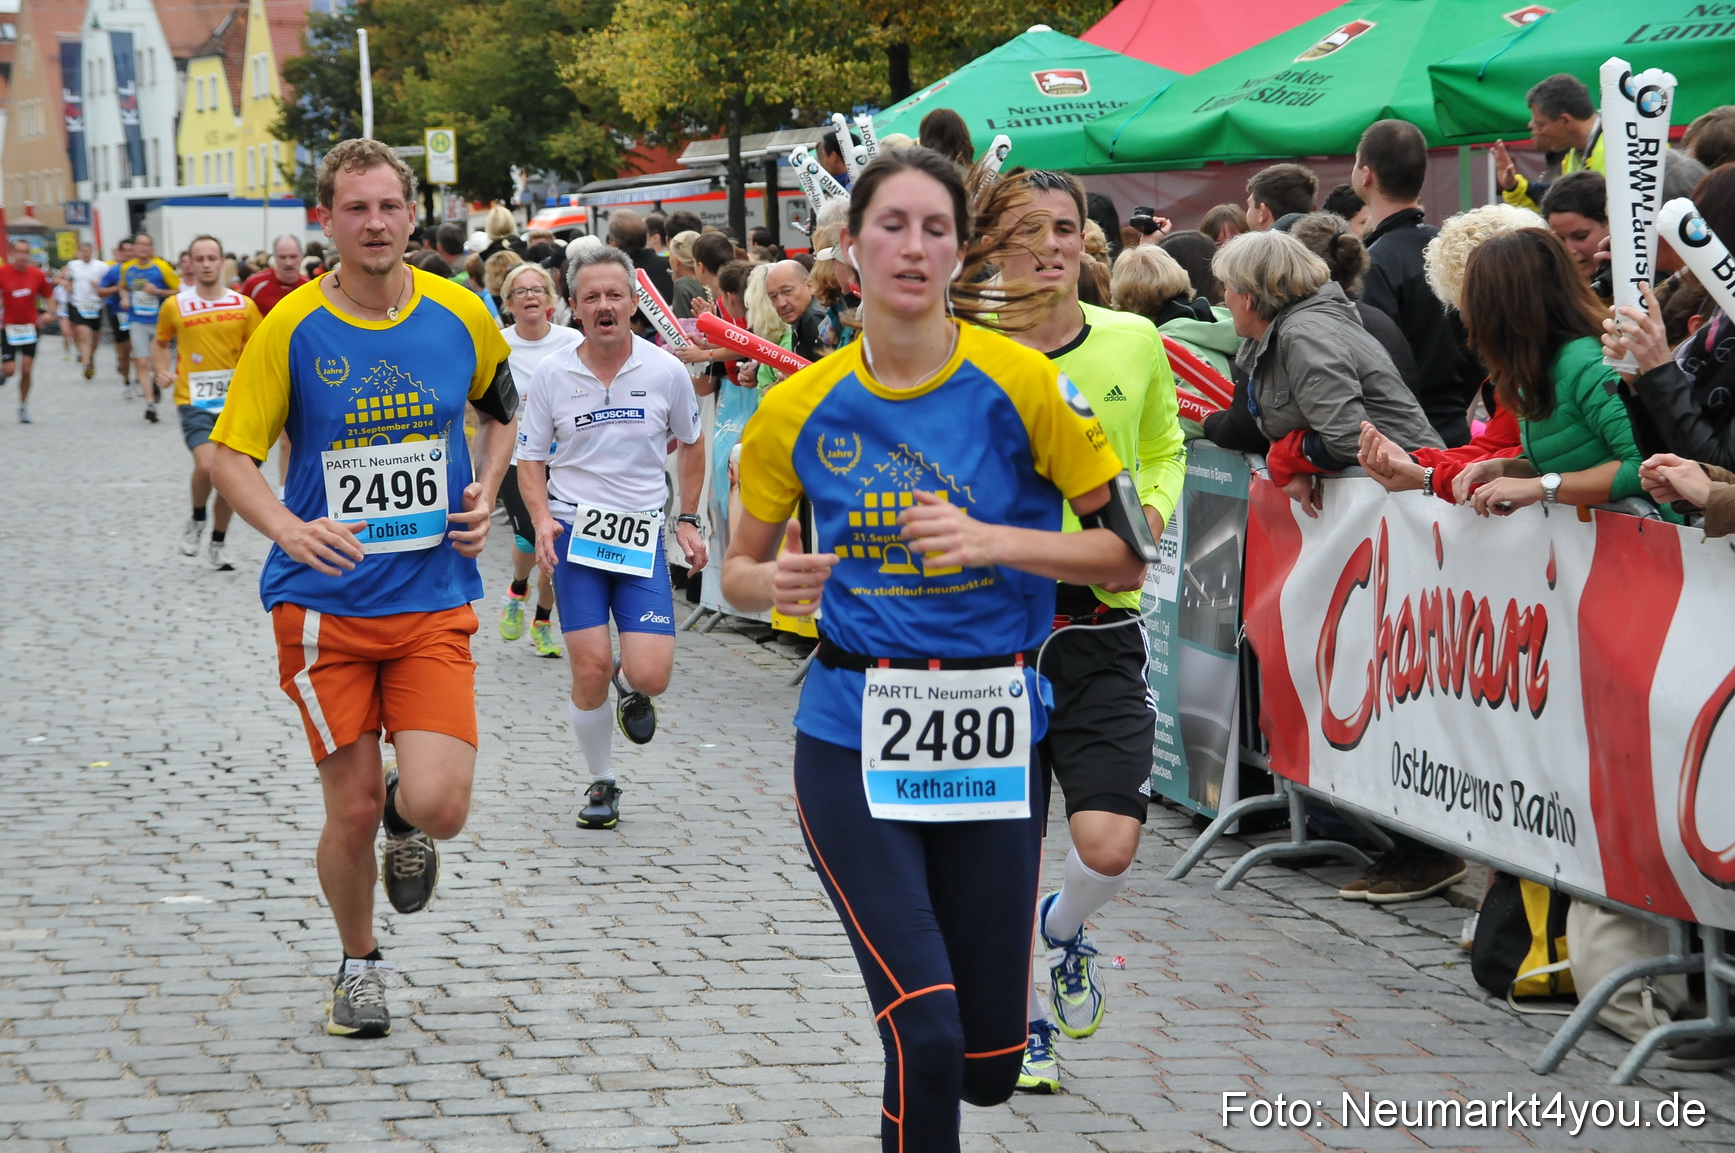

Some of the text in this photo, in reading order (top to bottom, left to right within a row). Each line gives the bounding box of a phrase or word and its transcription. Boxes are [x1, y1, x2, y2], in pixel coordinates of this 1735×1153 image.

[756, 343, 779, 360] BKK
[323, 367, 344, 375] Jahre
[412, 419, 434, 428] 2014
[833, 437, 846, 447] 15
[326, 452, 426, 471] PARTL Neumarkt
[827, 449, 853, 459] Jahre
[339, 466, 438, 514] 2496
[366, 521, 418, 540] Tobias
[581, 508, 652, 547] 2305
[596, 546, 627, 565] Harry
[1315, 515, 1557, 752] Charivari
[868, 684, 1003, 700] PARTL Neumarkt
[880, 706, 1015, 762] 2480
[895, 776, 996, 799] Katharina
[1391, 740, 1576, 848] Ostbayerns Radio
